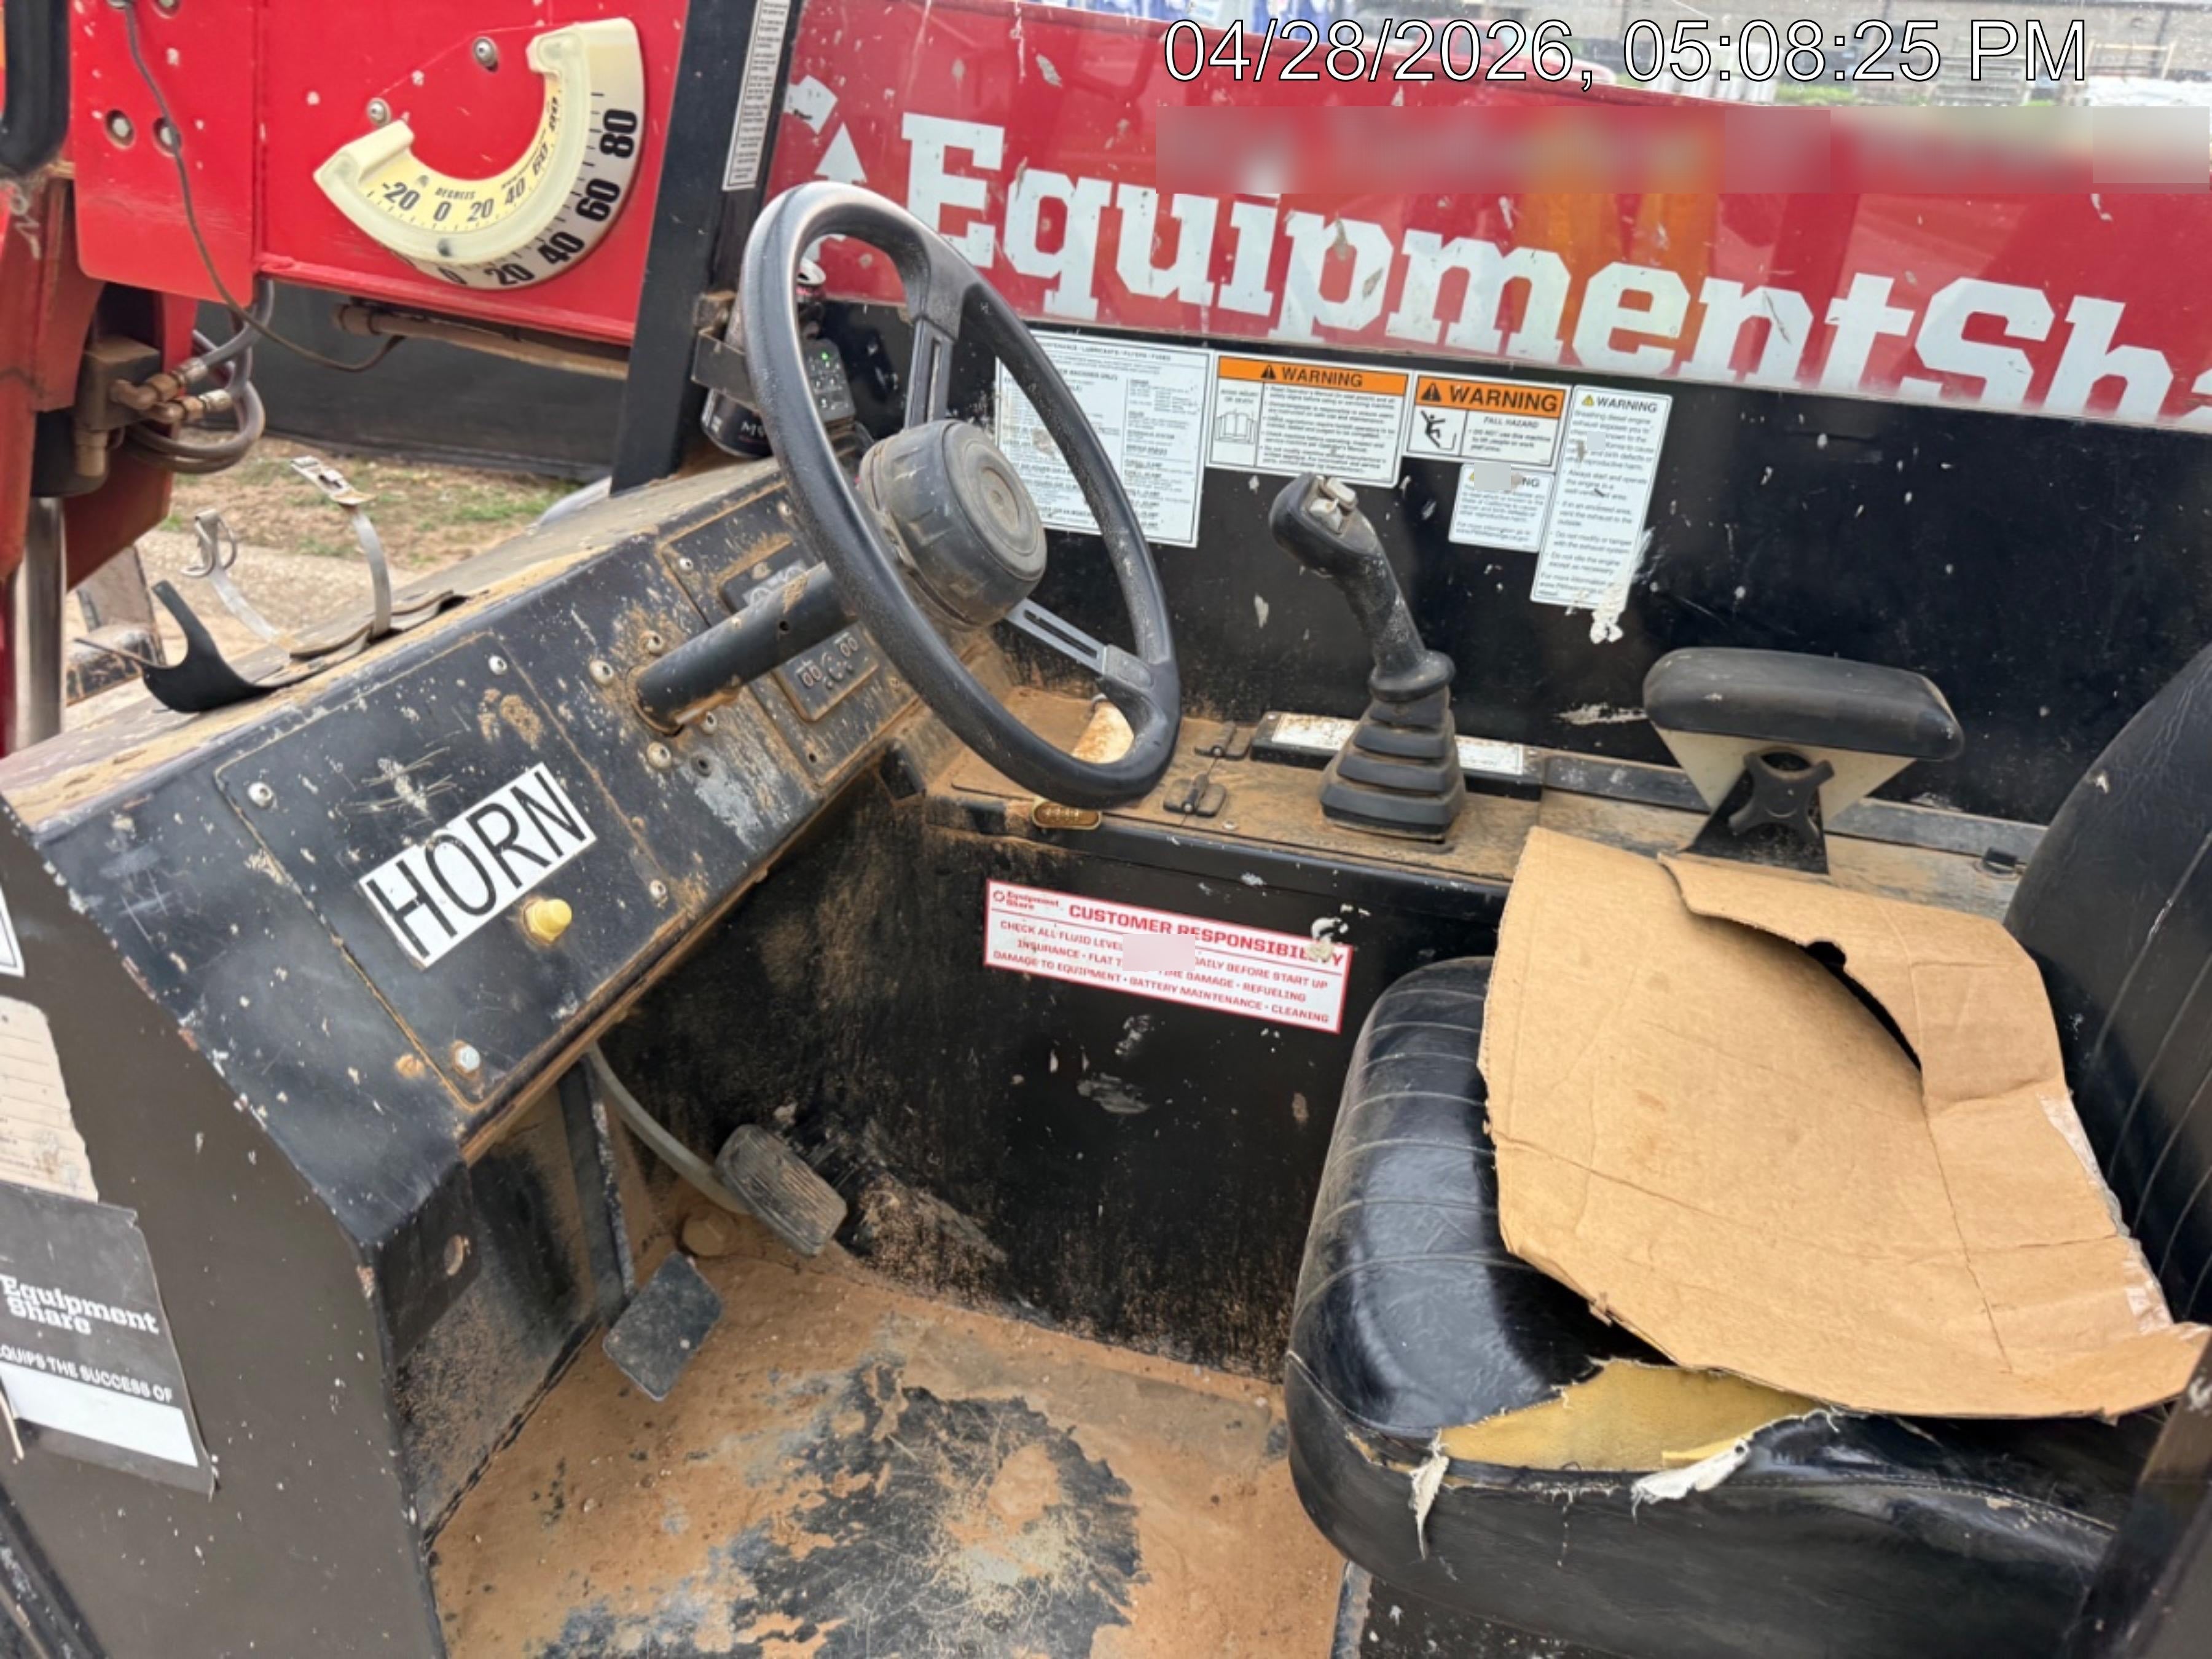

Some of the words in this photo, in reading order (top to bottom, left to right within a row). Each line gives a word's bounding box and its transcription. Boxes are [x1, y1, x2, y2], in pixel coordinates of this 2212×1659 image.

[598, 108, 637, 159] 80
[382, 182, 421, 210] -20
[433, 201, 452, 221] 0
[467, 198, 495, 222] 20
[575, 178, 621, 222] 60
[537, 232, 585, 265] 40
[483, 263, 535, 286] 20
[901, 111, 2212, 431] EquipmentSh
[1281, 366, 1363, 388] WARNING
[1449, 384, 1558, 413] WARNING
[1596, 396, 1658, 414] WARNING
[366, 771, 587, 959] HORN
[1006, 891, 1059, 907] Equipment
[1006, 900, 1035, 910] Share
[1000, 920, 1035, 934] CHECK
[1038, 926, 1056, 939] ALL
[1059, 931, 1092, 945] FLUID
[1069, 904, 1172, 935] CUSTOMER
[1177, 924, 1344, 967] RESPONSIBILY
[1017, 939, 1080, 959] INSURANCE
[1089, 952, 1113, 965] FLAT
[1186, 970, 1234, 988] DAMAGE
[1242, 982, 1306, 1002] REFUELING
[1226, 963, 1270, 979] BEFORE
[1273, 971, 1309, 986] START
[1312, 979, 1328, 989] UP
[993, 951, 1038, 967] DAMAGE
[1041, 960, 1055, 970] TO
[1057, 962, 1121, 984] EQUIPMENT
[1129, 976, 1177, 995] BATTERY
[1179, 986, 1263, 1011] MAINTENANCE
[1271, 1004, 1330, 1024] CLEANING
[0, 1273, 160, 1336] Equipment
[7, 1298, 92, 1336] Share
[49, 1356, 79, 1379] THE
[80, 1364, 149, 1398] SUCCESS
[153, 1386, 174, 1404] OF
